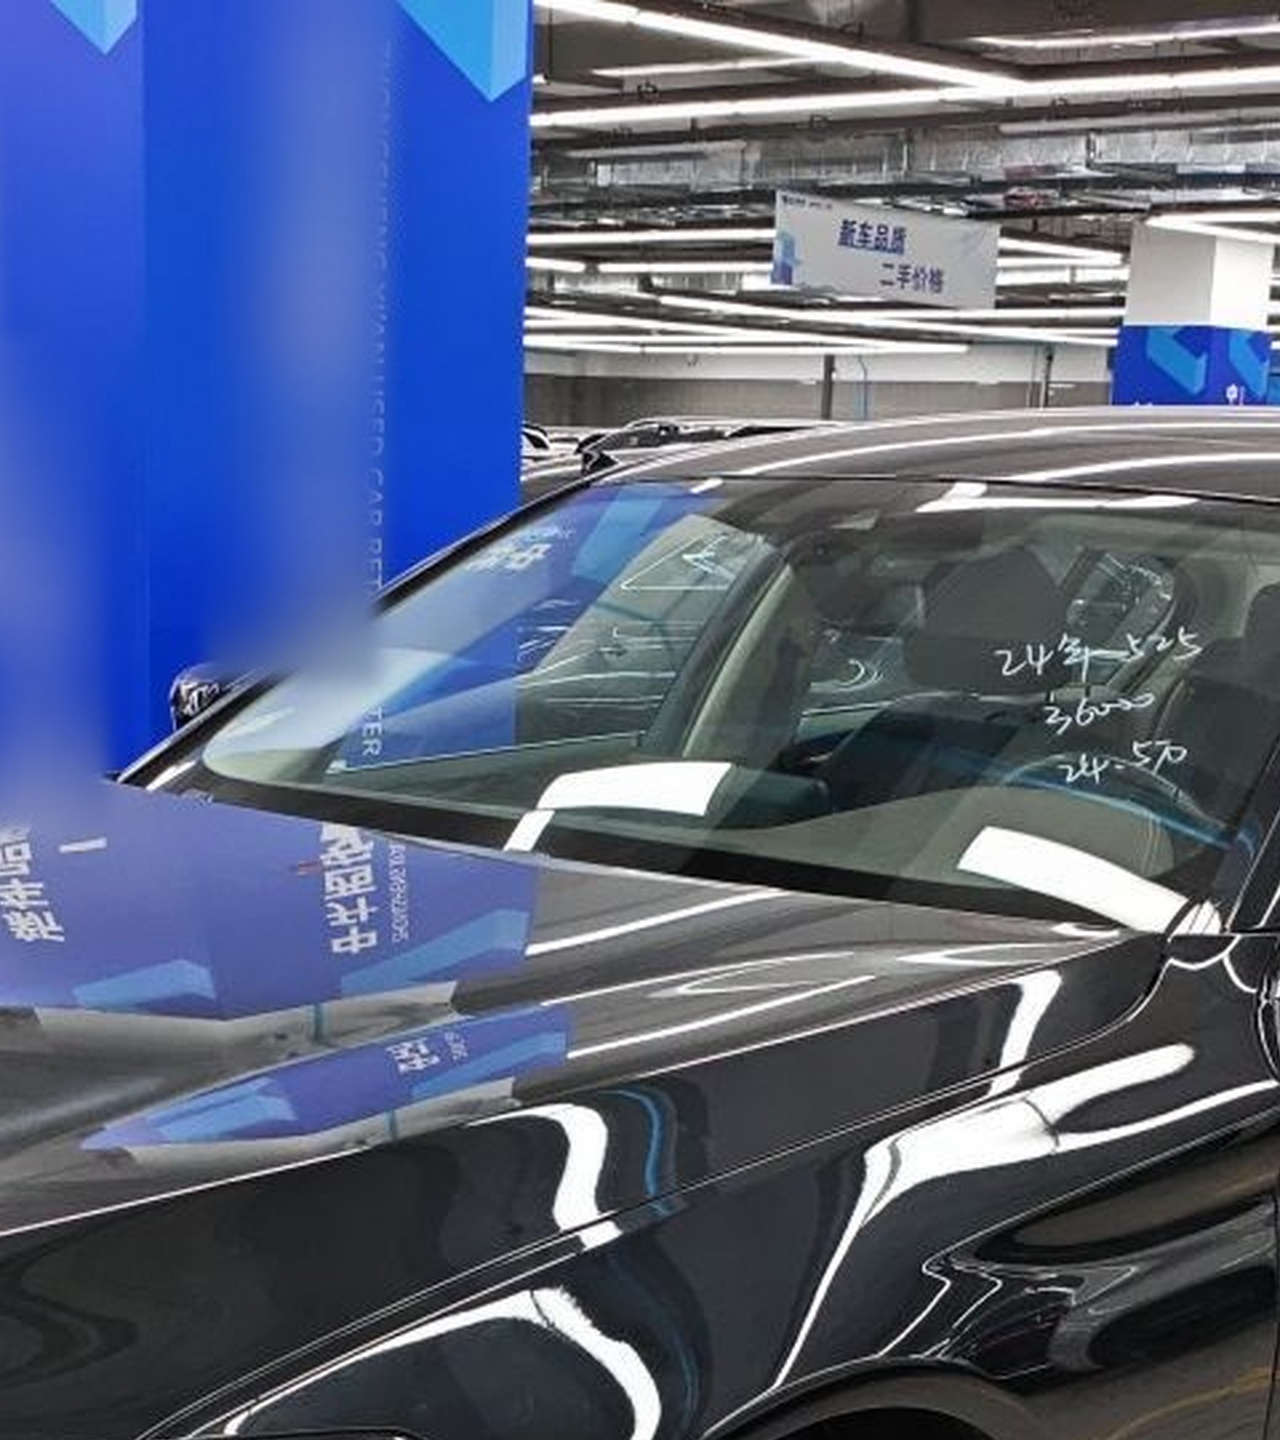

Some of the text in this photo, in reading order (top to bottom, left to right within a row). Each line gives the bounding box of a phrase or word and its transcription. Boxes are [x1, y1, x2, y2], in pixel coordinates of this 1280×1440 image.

[838, 219, 907, 255] 新车品质
[880, 262, 945, 295] 二手价格
